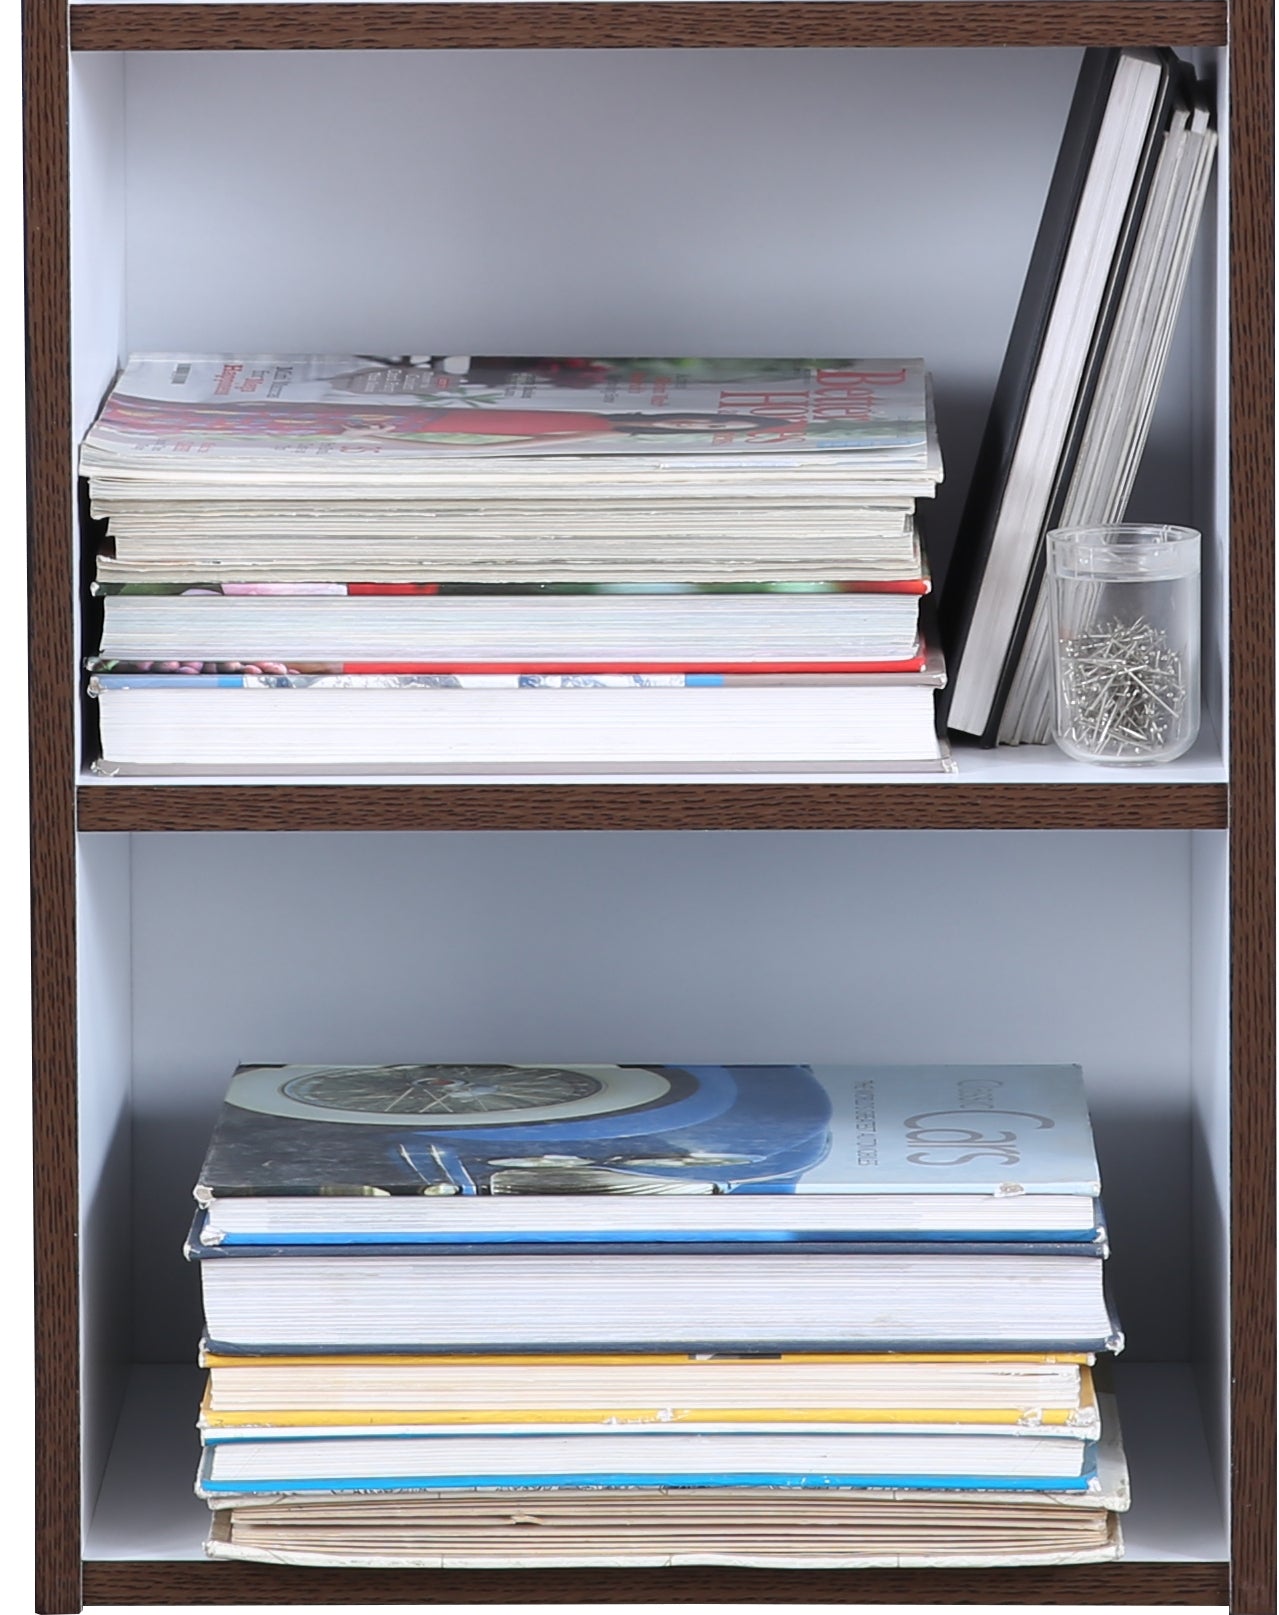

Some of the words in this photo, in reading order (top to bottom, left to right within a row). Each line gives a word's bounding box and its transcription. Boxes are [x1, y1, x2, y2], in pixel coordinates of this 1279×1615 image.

[718, 390, 809, 444] Hoes
[813, 368, 907, 422] Better
[903, 1110, 1056, 1166] Cars
